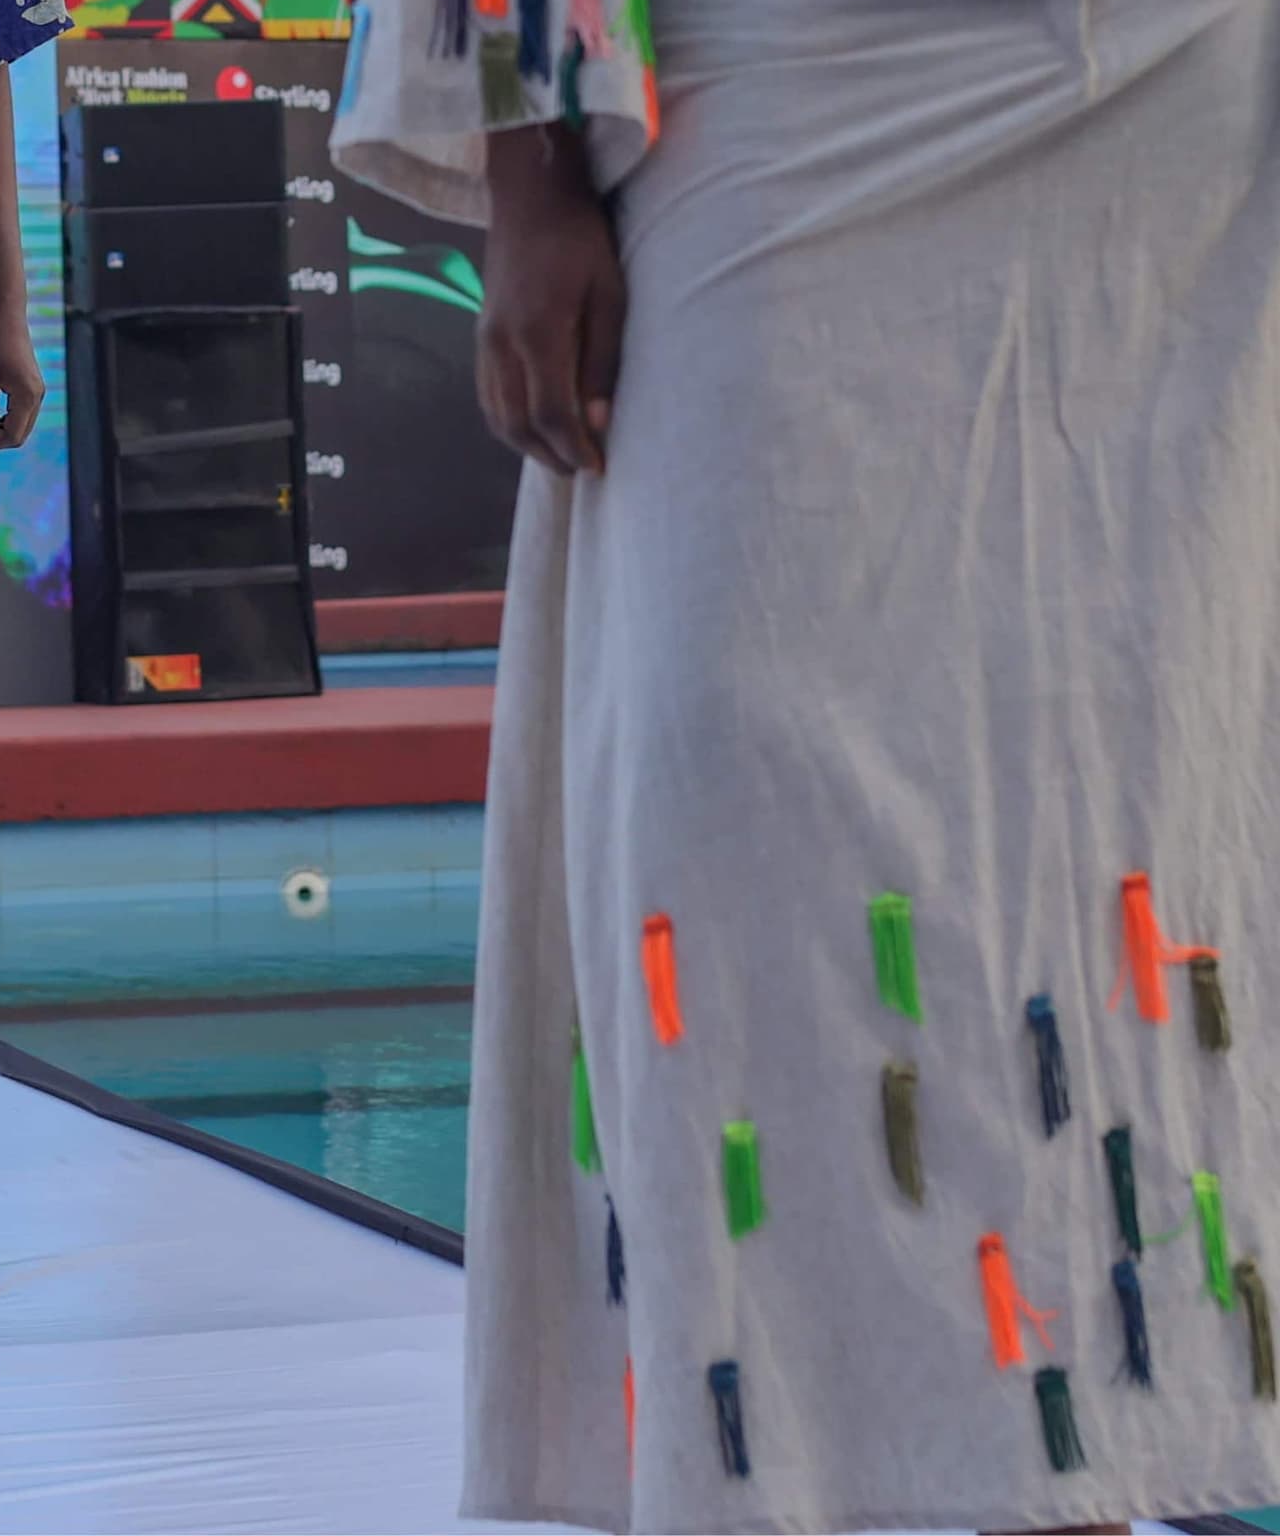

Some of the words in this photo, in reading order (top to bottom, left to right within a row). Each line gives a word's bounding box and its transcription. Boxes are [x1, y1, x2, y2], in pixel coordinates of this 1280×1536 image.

[302, 359, 342, 387] ling
[305, 451, 345, 479] ling
[309, 543, 348, 571] ling
